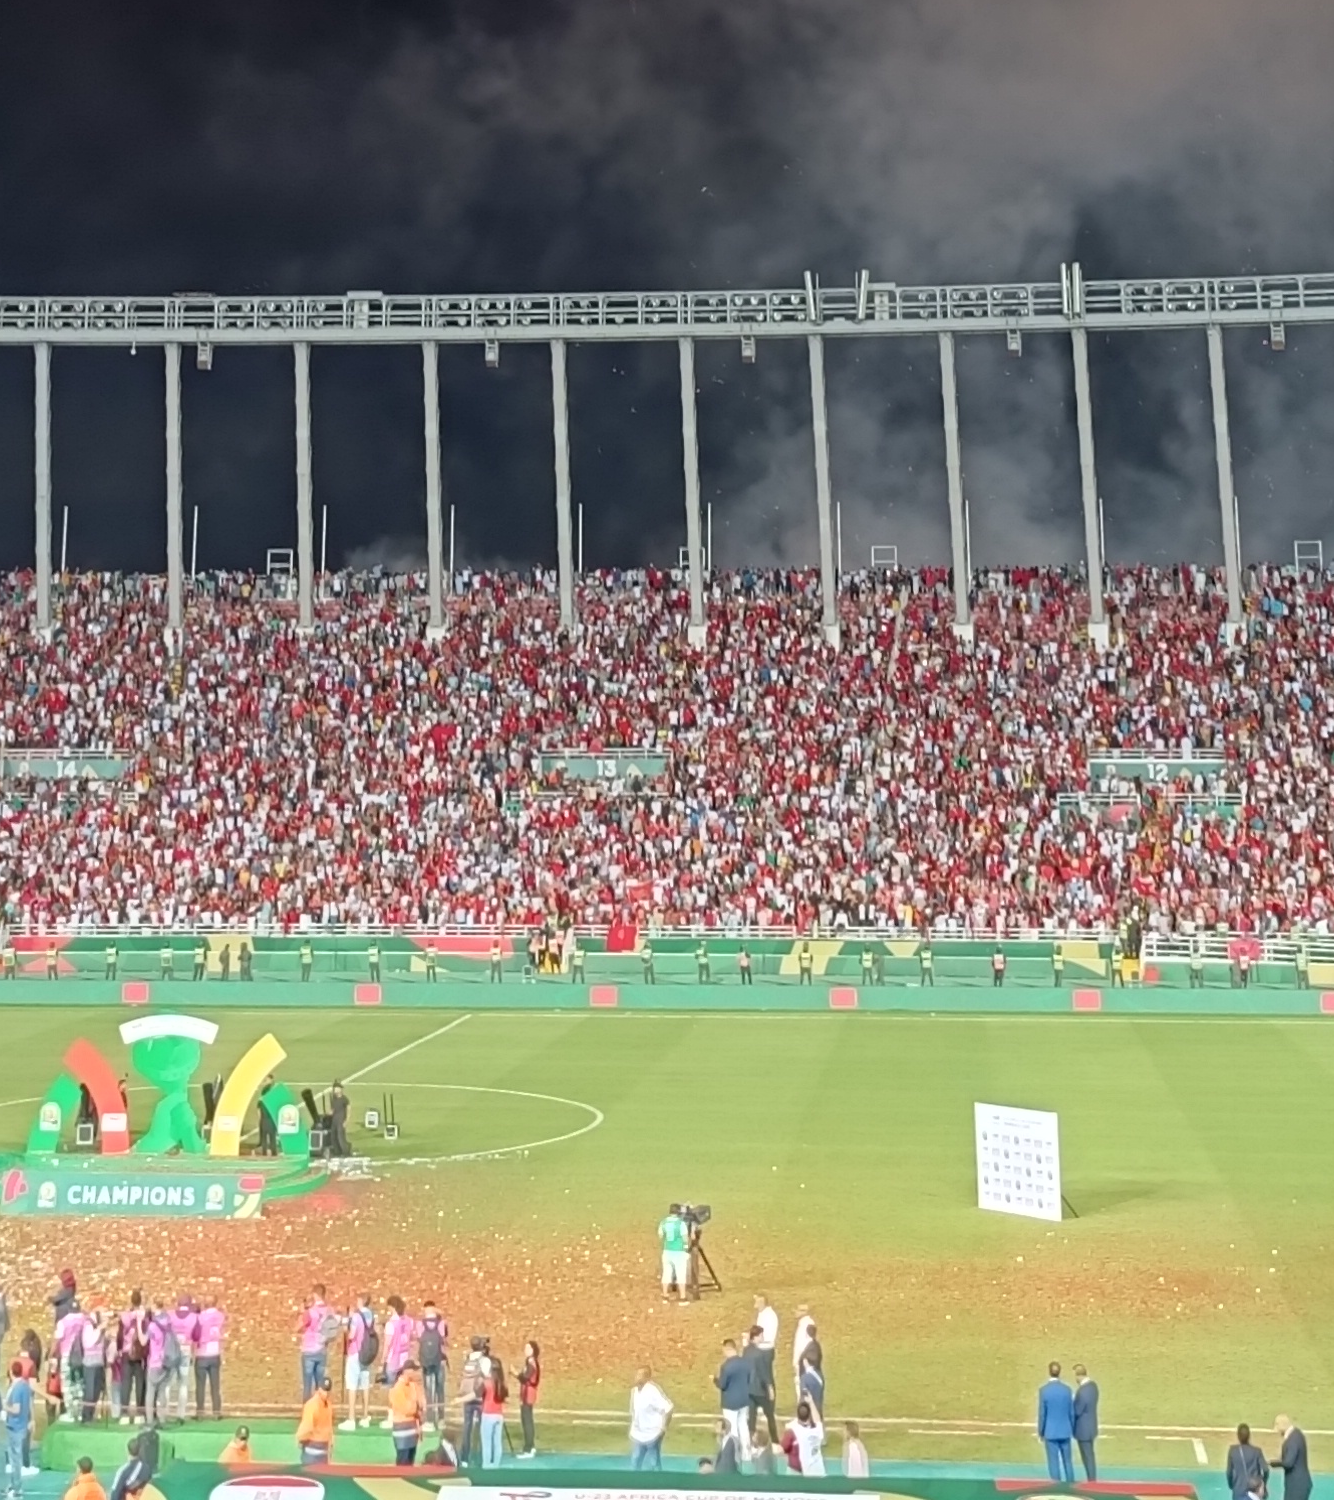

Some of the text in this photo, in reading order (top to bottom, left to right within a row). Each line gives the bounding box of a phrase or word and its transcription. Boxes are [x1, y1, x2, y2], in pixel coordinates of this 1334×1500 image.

[56, 760, 77, 779] 14
[596, 759, 617, 778] 13
[1147, 763, 1168, 782] 12
[66, 1184, 196, 1208] CHAMPIONS
